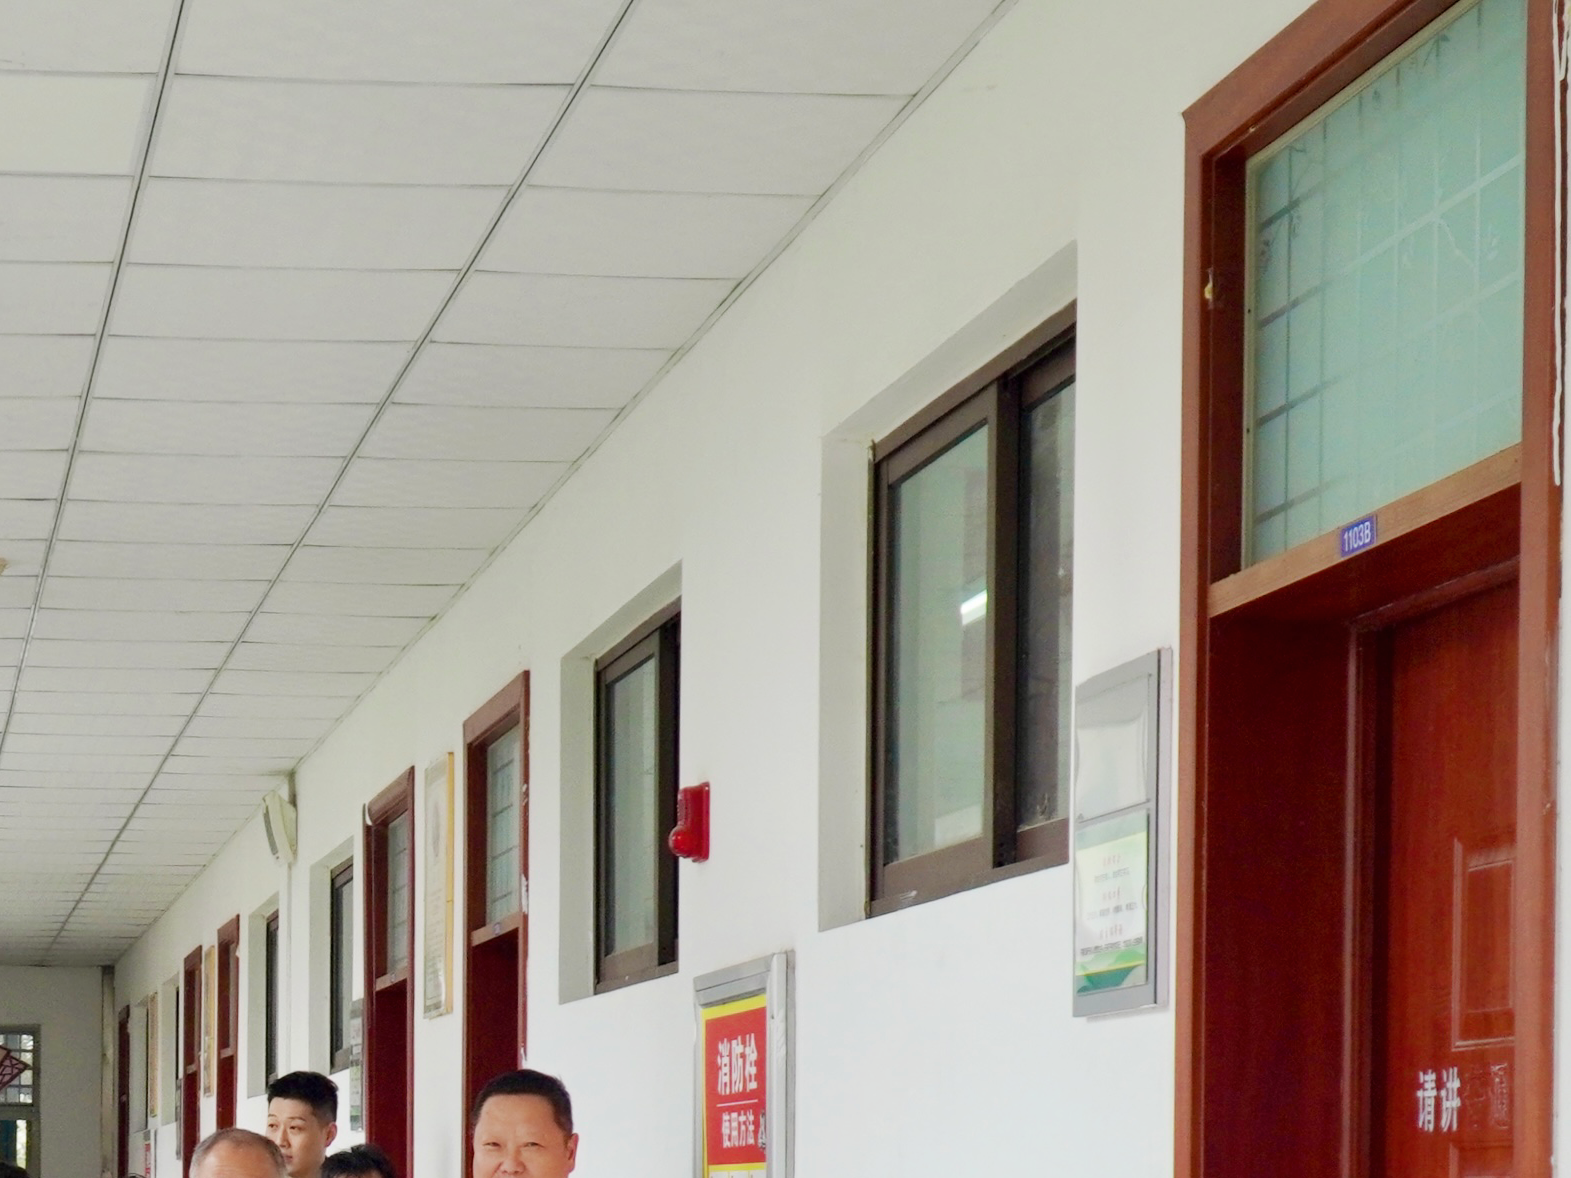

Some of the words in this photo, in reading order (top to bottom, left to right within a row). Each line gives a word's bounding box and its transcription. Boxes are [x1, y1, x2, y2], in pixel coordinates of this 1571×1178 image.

[1344, 521, 1371, 551] 1103B
[716, 1033, 758, 1095] 消防栓
[722, 1109, 755, 1149] 使用方法
